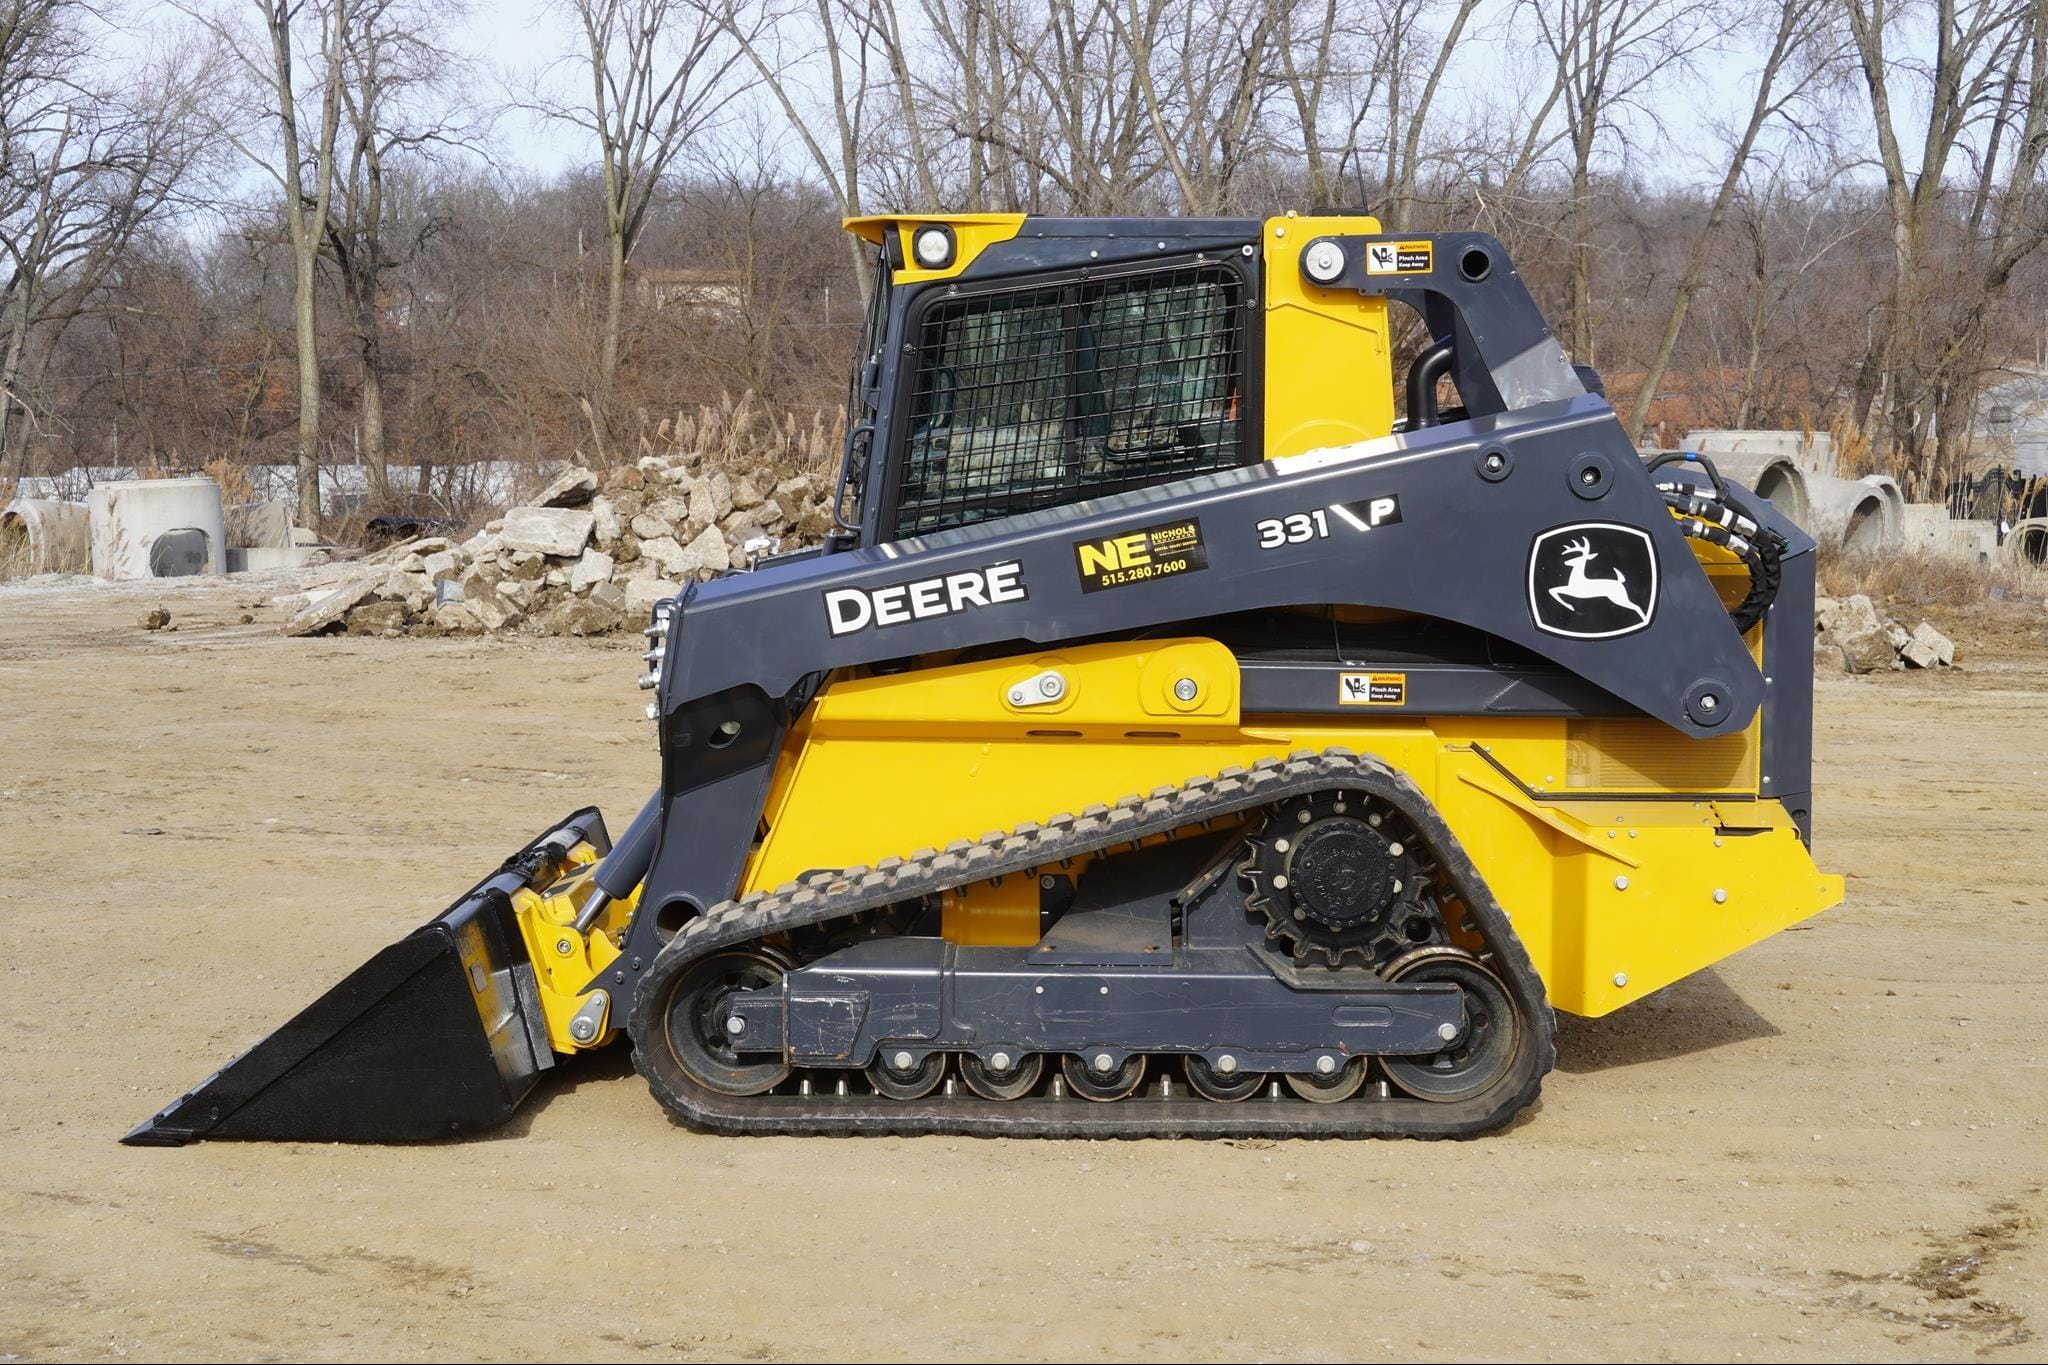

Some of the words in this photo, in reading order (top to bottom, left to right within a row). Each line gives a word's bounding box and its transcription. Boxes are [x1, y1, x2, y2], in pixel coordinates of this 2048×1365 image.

[1151, 525, 1195, 540] NICHOLS
[1257, 509, 1329, 549] 331
[1079, 533, 1151, 576] NE
[1102, 559, 1187, 586] 515.280.7600
[825, 563, 1025, 635] DEERE
